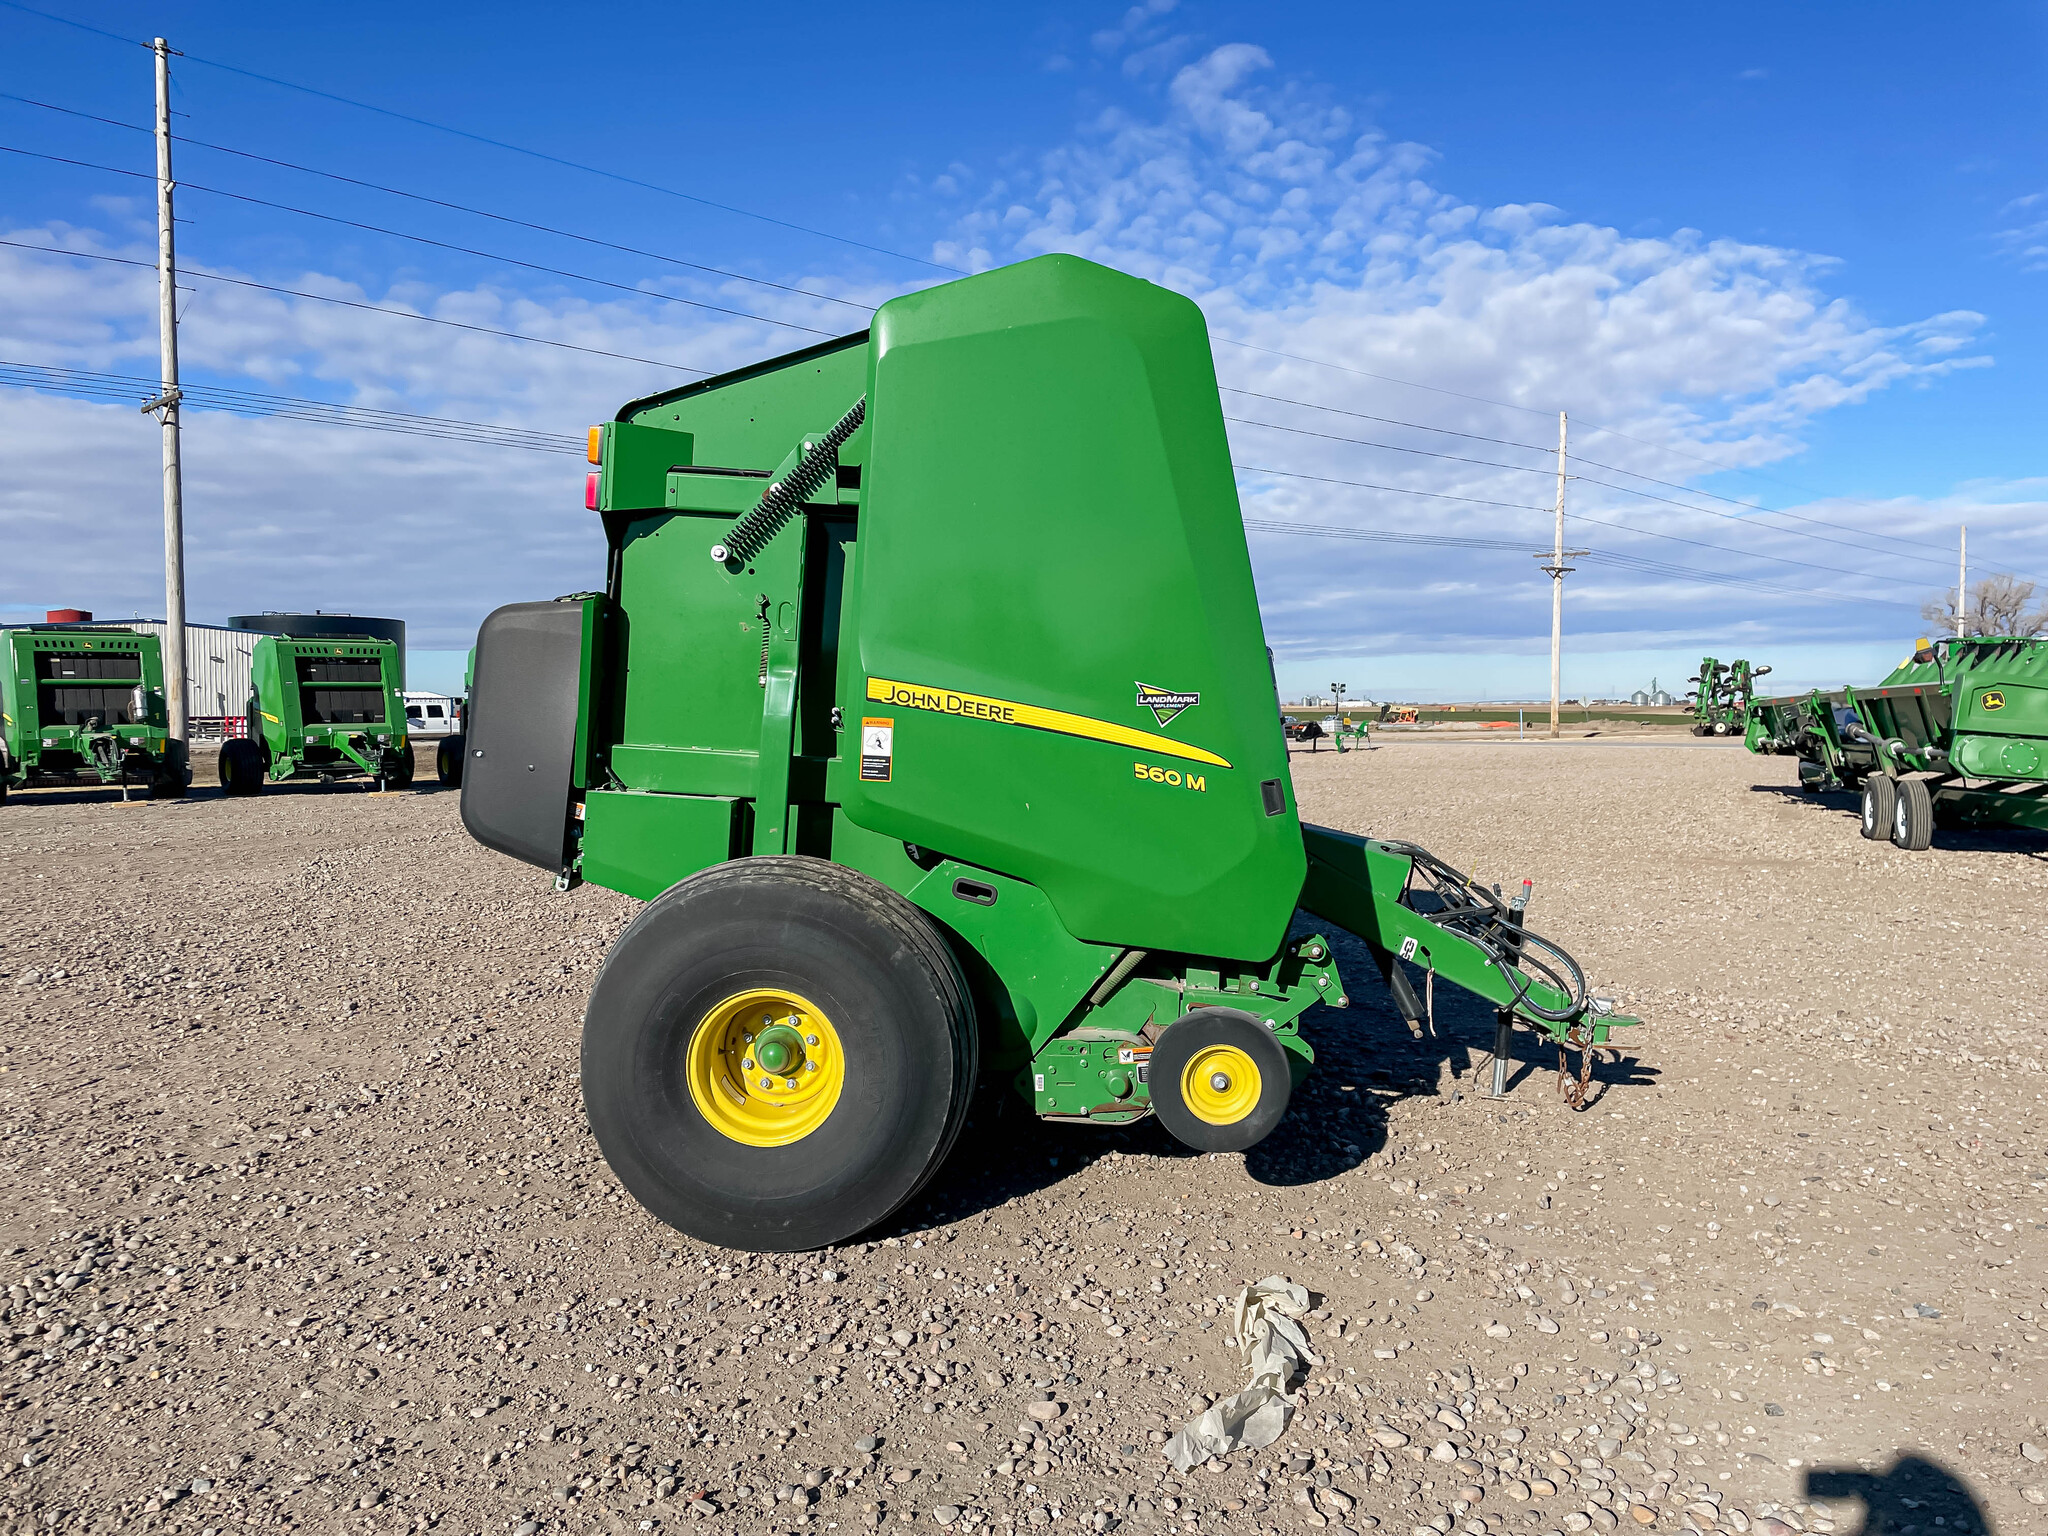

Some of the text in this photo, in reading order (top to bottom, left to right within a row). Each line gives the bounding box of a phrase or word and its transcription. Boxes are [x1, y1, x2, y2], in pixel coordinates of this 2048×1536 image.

[884, 685, 1015, 721] JOHN DEERE
[1134, 762, 1206, 793] 560 M
